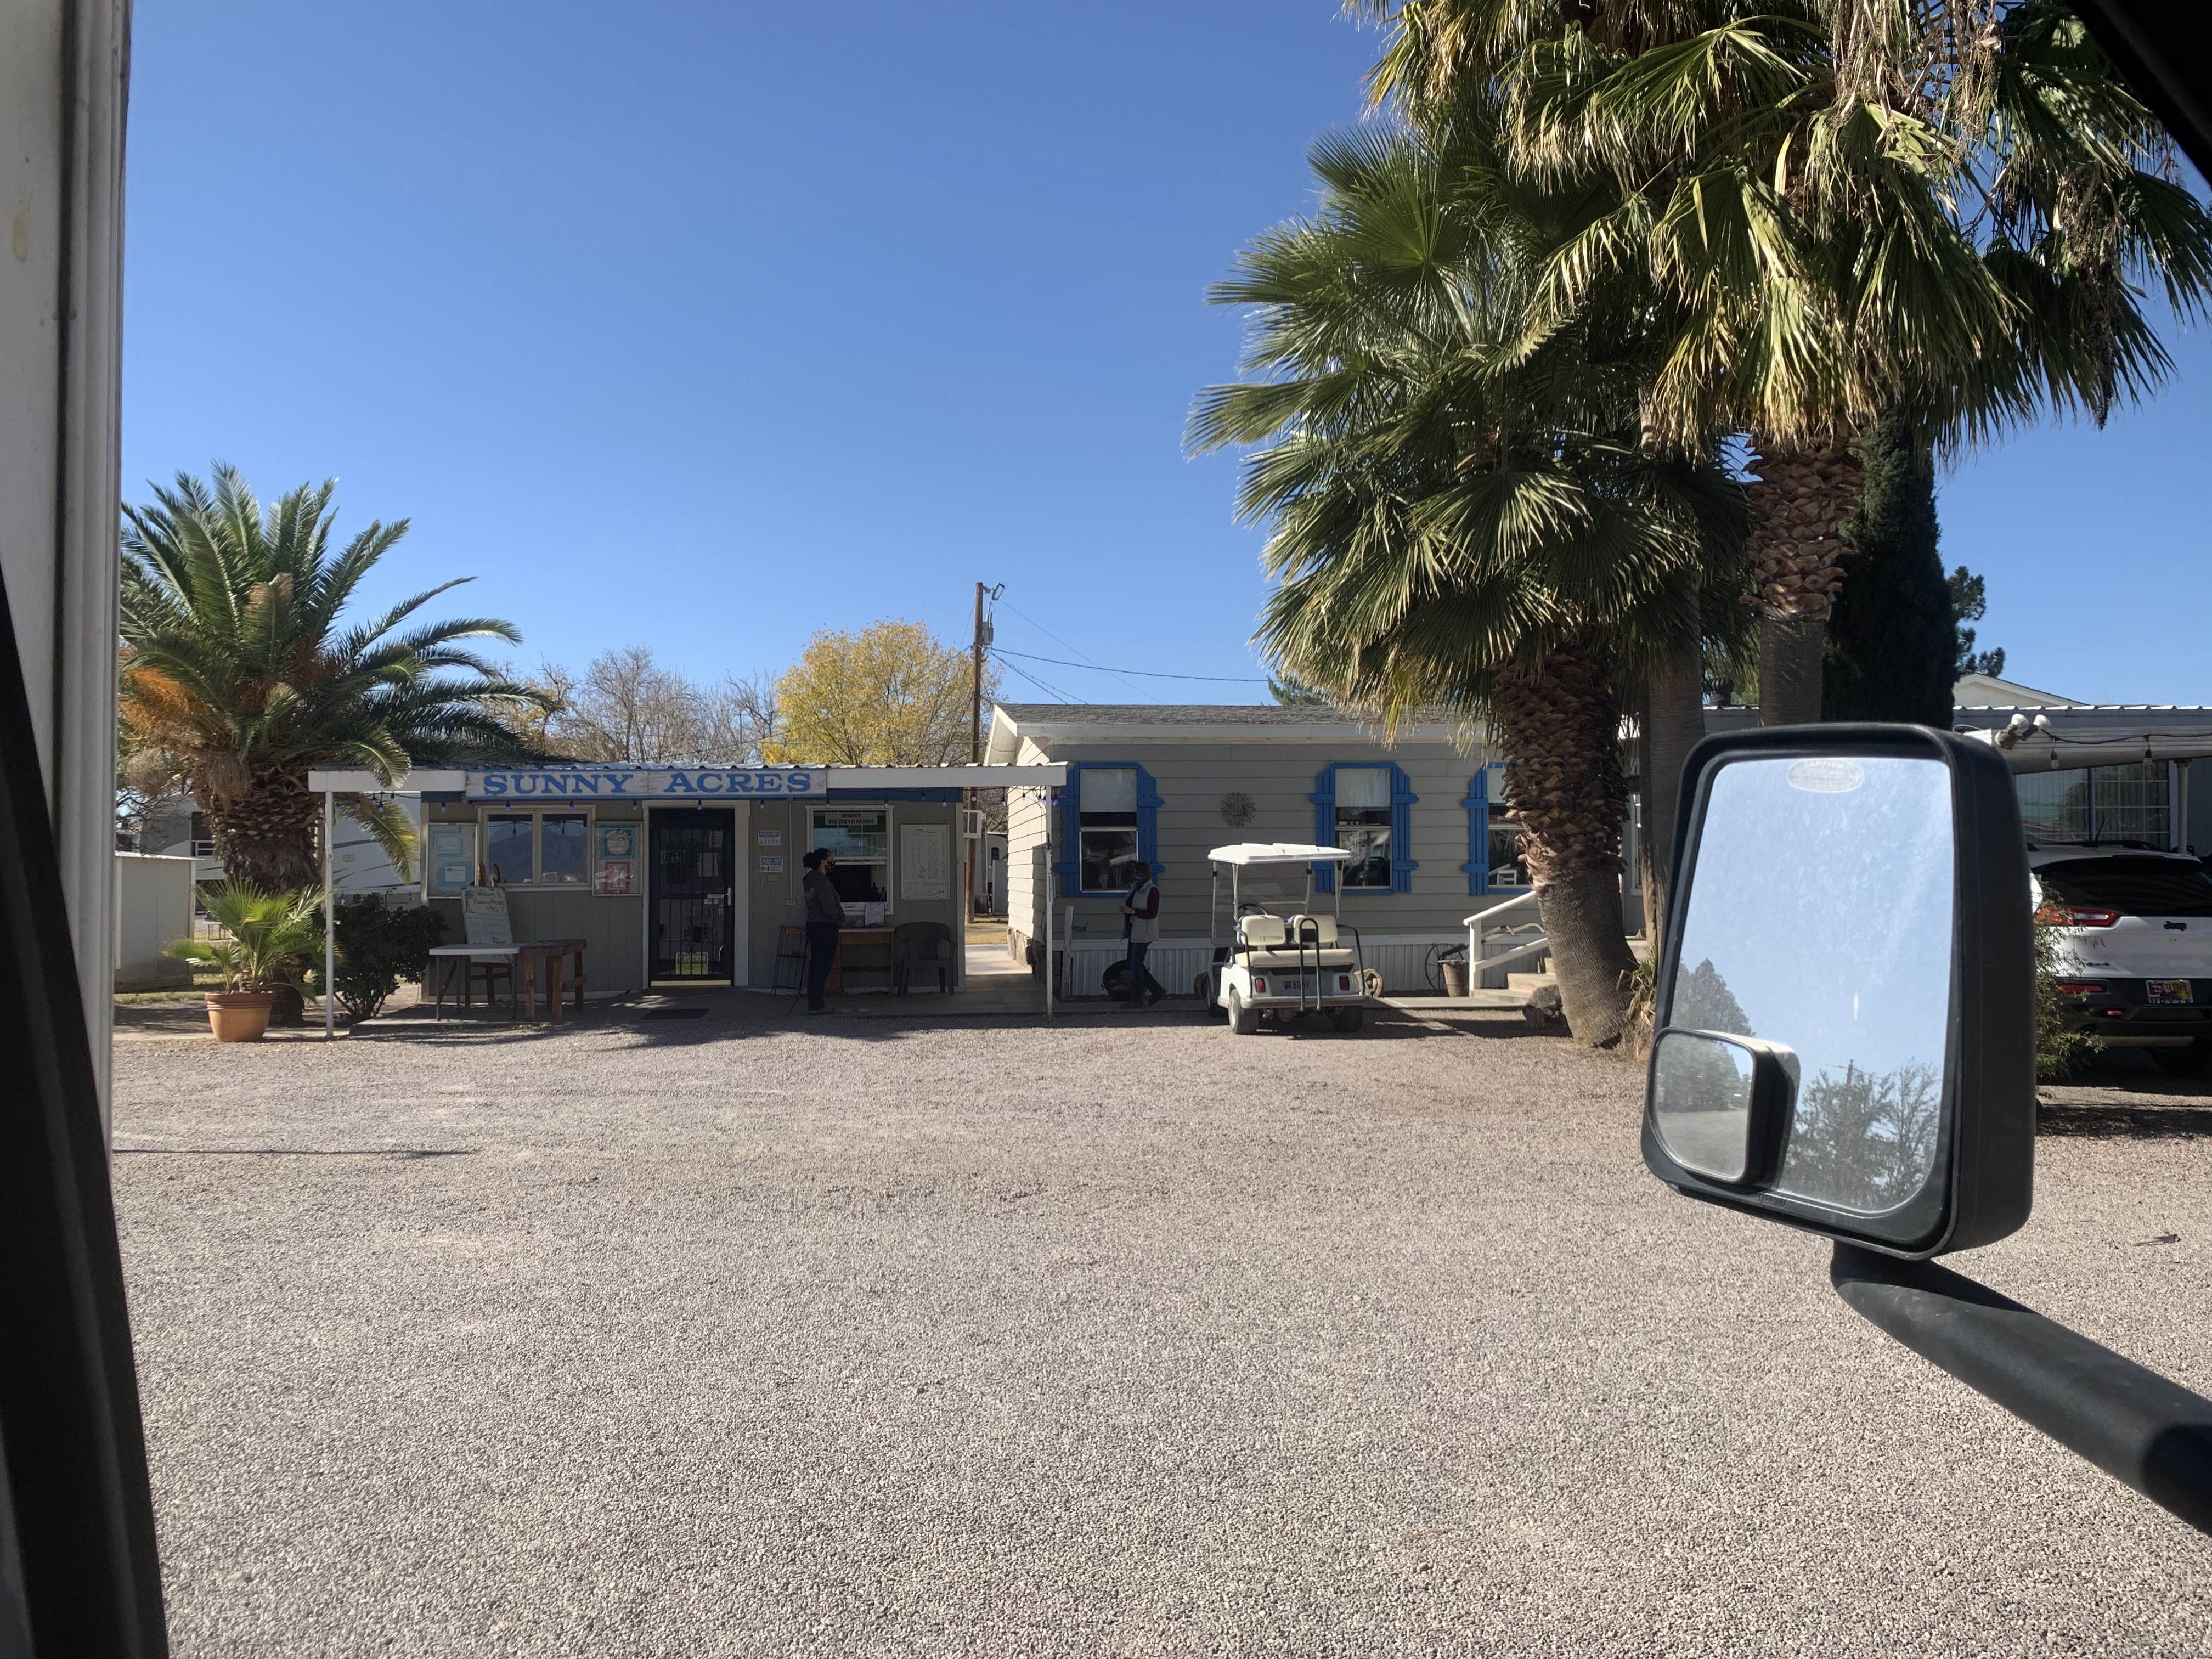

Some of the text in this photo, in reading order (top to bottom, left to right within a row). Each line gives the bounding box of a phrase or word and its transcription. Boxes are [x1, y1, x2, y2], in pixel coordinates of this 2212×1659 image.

[483, 772, 811, 794] SUNNY ACRES
[2163, 921, 2187, 931] Jeep
